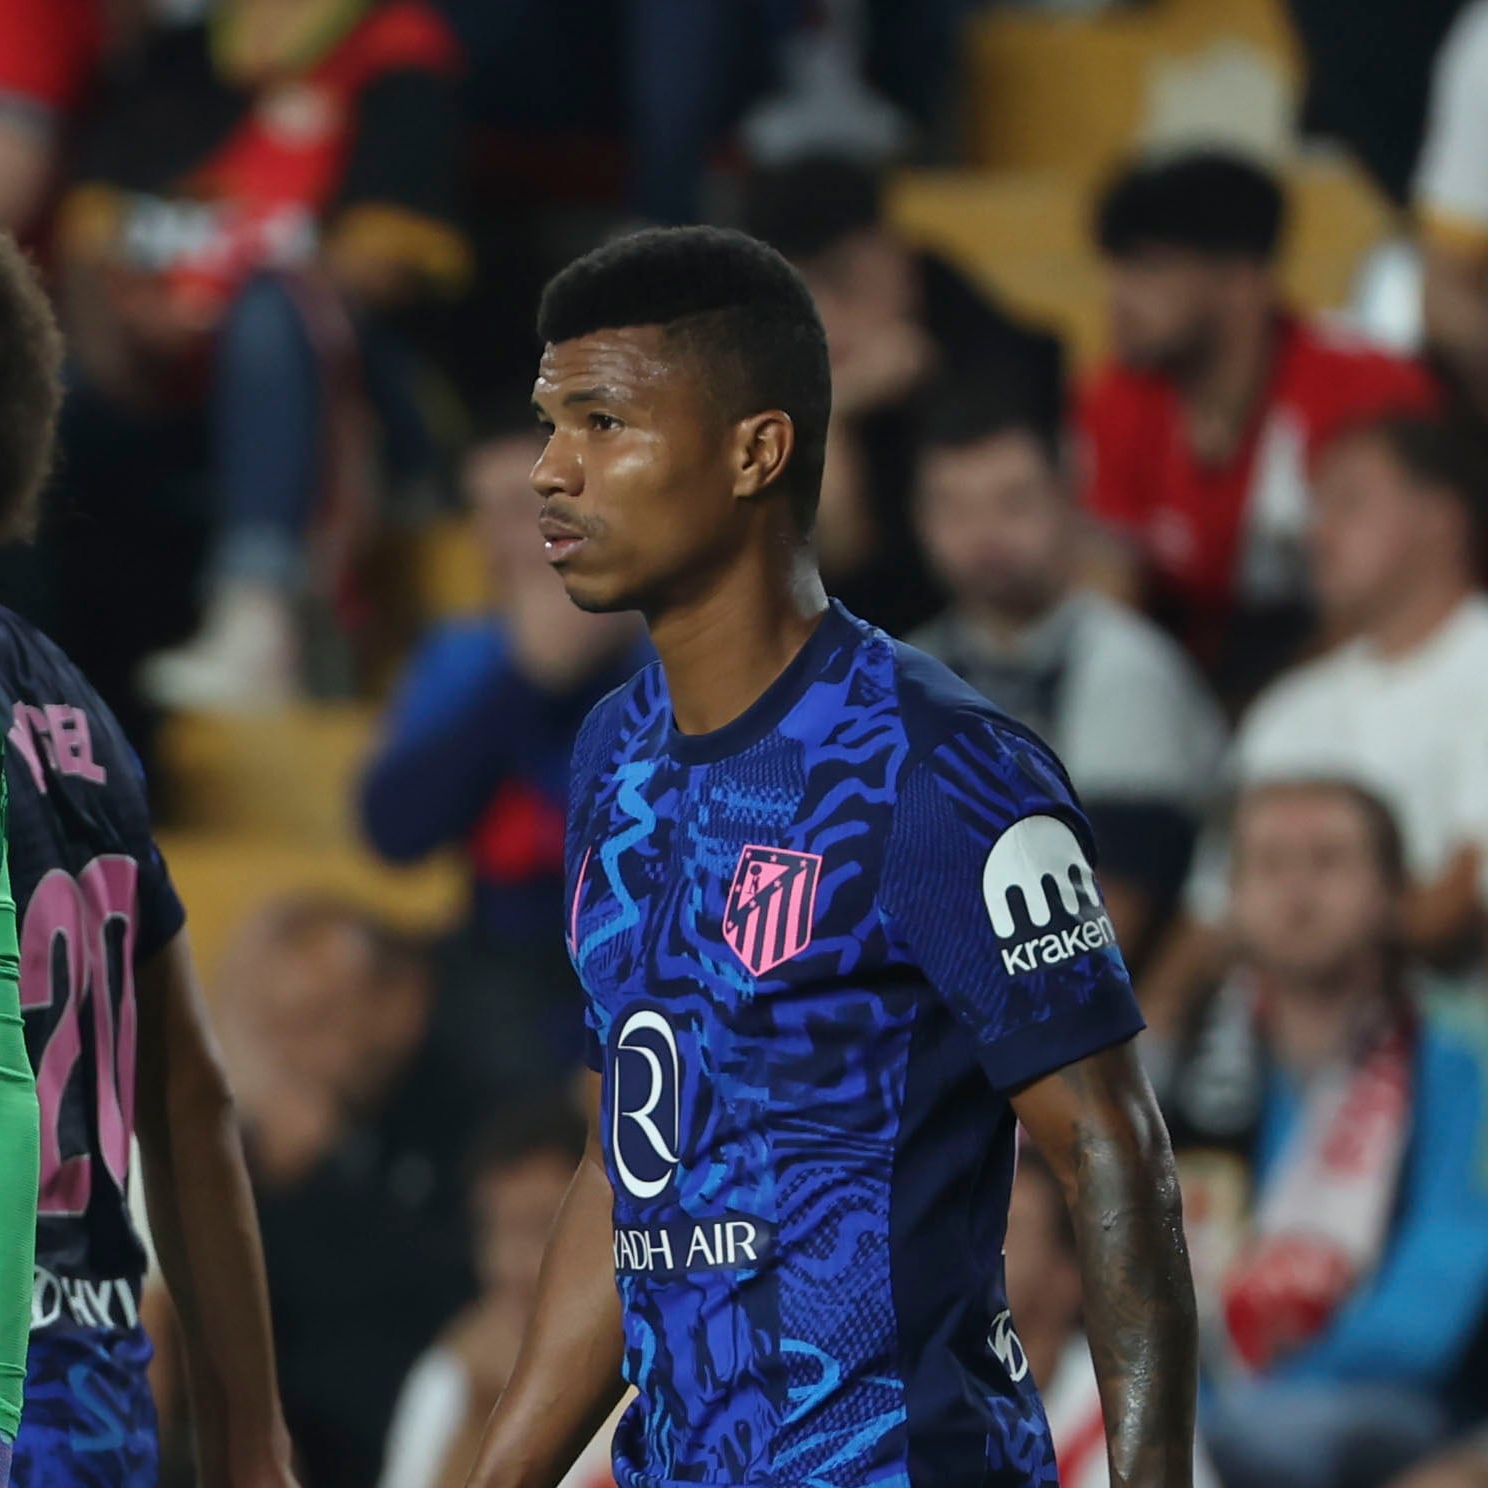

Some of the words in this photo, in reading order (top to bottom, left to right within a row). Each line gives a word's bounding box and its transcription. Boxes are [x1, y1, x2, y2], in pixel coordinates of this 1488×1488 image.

[1001, 914, 1116, 976] kraken
[20, 854, 138, 1217] 20
[685, 1221, 758, 1268] AIR
